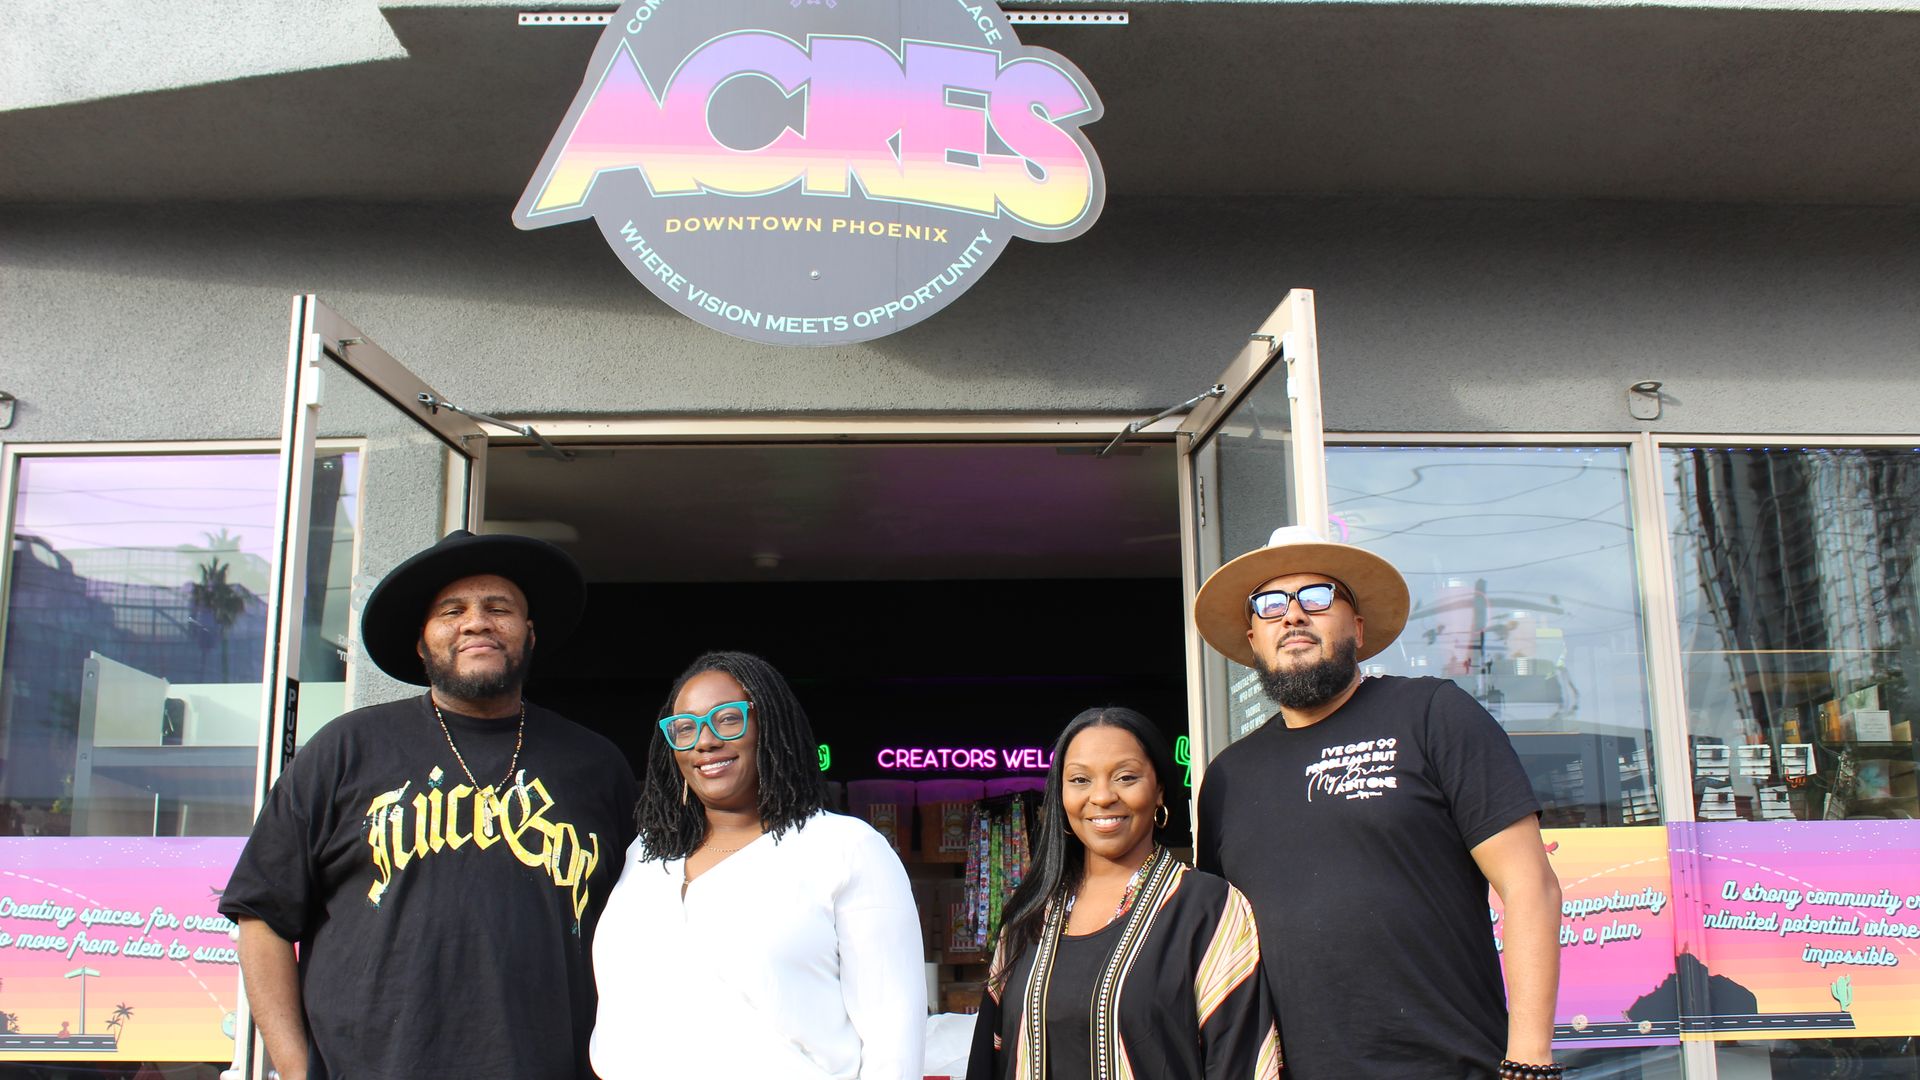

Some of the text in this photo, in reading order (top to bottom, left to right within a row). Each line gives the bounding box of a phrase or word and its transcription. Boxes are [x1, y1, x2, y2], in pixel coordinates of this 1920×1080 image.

[526, 29, 1094, 230] ACRES
[665, 216, 949, 243] DOWNTOWN PHOENIX
[619, 219, 993, 334] WHERE VISION MEETS OPPORTUNITY
[877, 748, 1055, 769] CREATORS WEL
[1344, 740, 1375, 754] GOT
[1376, 737, 1397, 750] 99
[1372, 750, 1397, 762] BUT
[1366, 776, 1397, 789] ONE
[1561, 886, 1667, 921] opportunity
[1721, 880, 1740, 901] A
[1742, 882, 1803, 912] strong
[1805, 889, 1903, 916] community
[0, 896, 76, 930] Creating
[79, 908, 145, 930] spaces
[143, 906, 180, 936] for
[1779, 914, 1861, 938] potential
[1863, 918, 1920, 939] where
[15, 933, 69, 953] move
[66, 930, 120, 961] from
[122, 935, 165, 960] idea
[167, 938, 191, 961] to
[1582, 926, 1598, 945] a
[1599, 919, 1642, 948] plan
[1801, 943, 1899, 968] impossible
